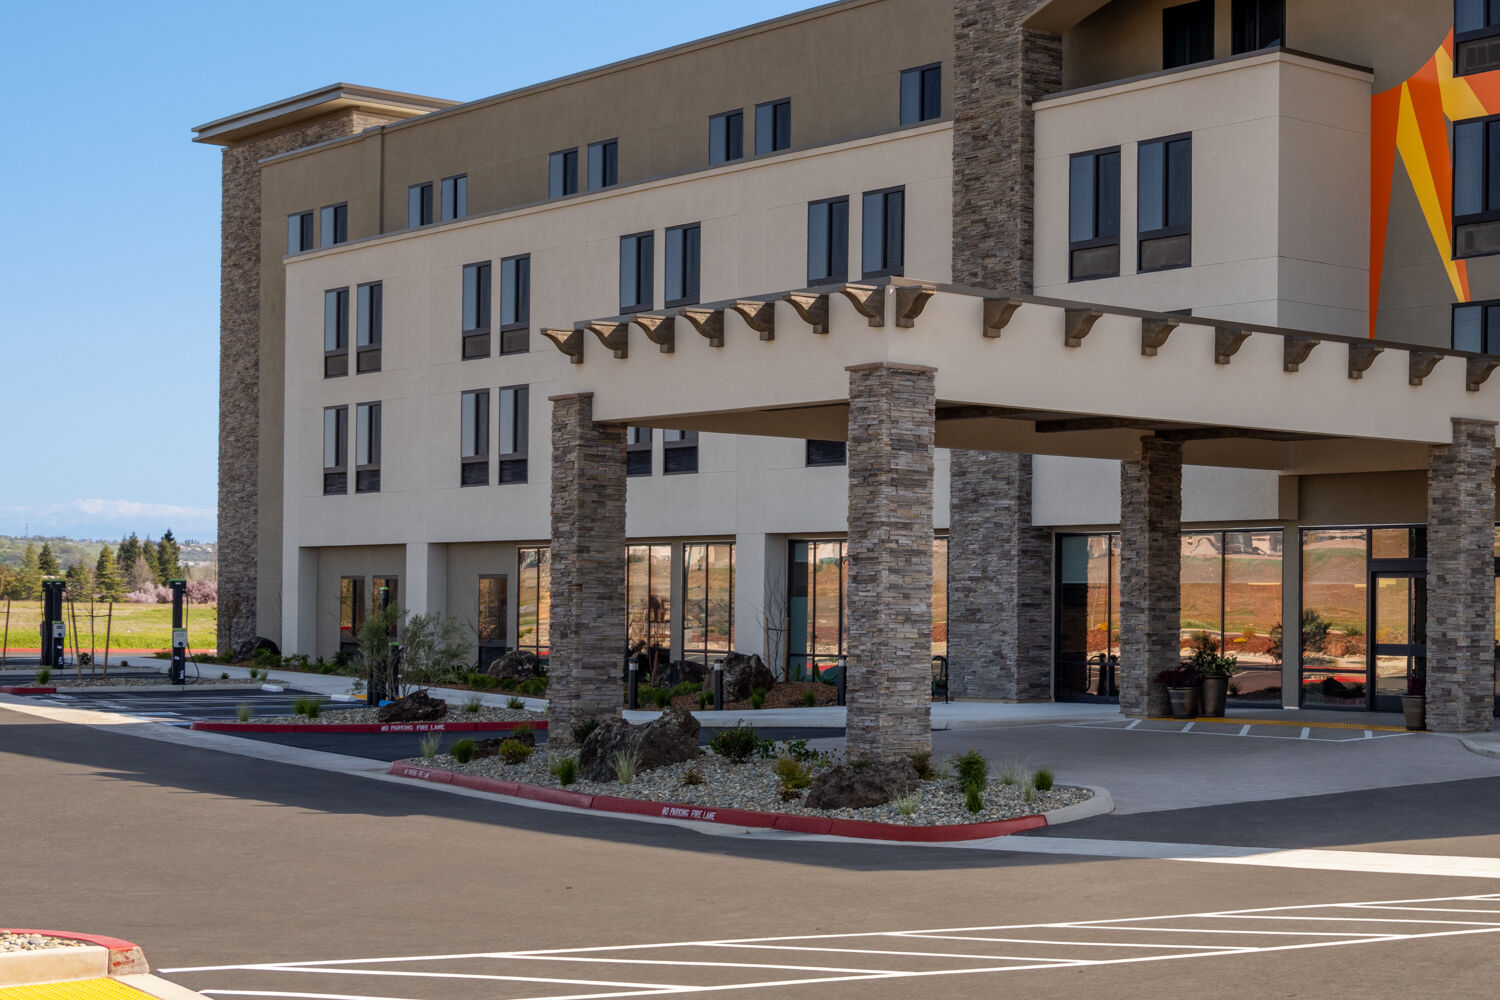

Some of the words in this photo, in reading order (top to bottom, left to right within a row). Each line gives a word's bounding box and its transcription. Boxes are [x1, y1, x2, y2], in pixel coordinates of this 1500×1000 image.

[661, 806, 669, 816] NO
[670, 807, 689, 817] PARKING
[691, 809, 702, 819] FIRE
[703, 811, 716, 820] LANE
